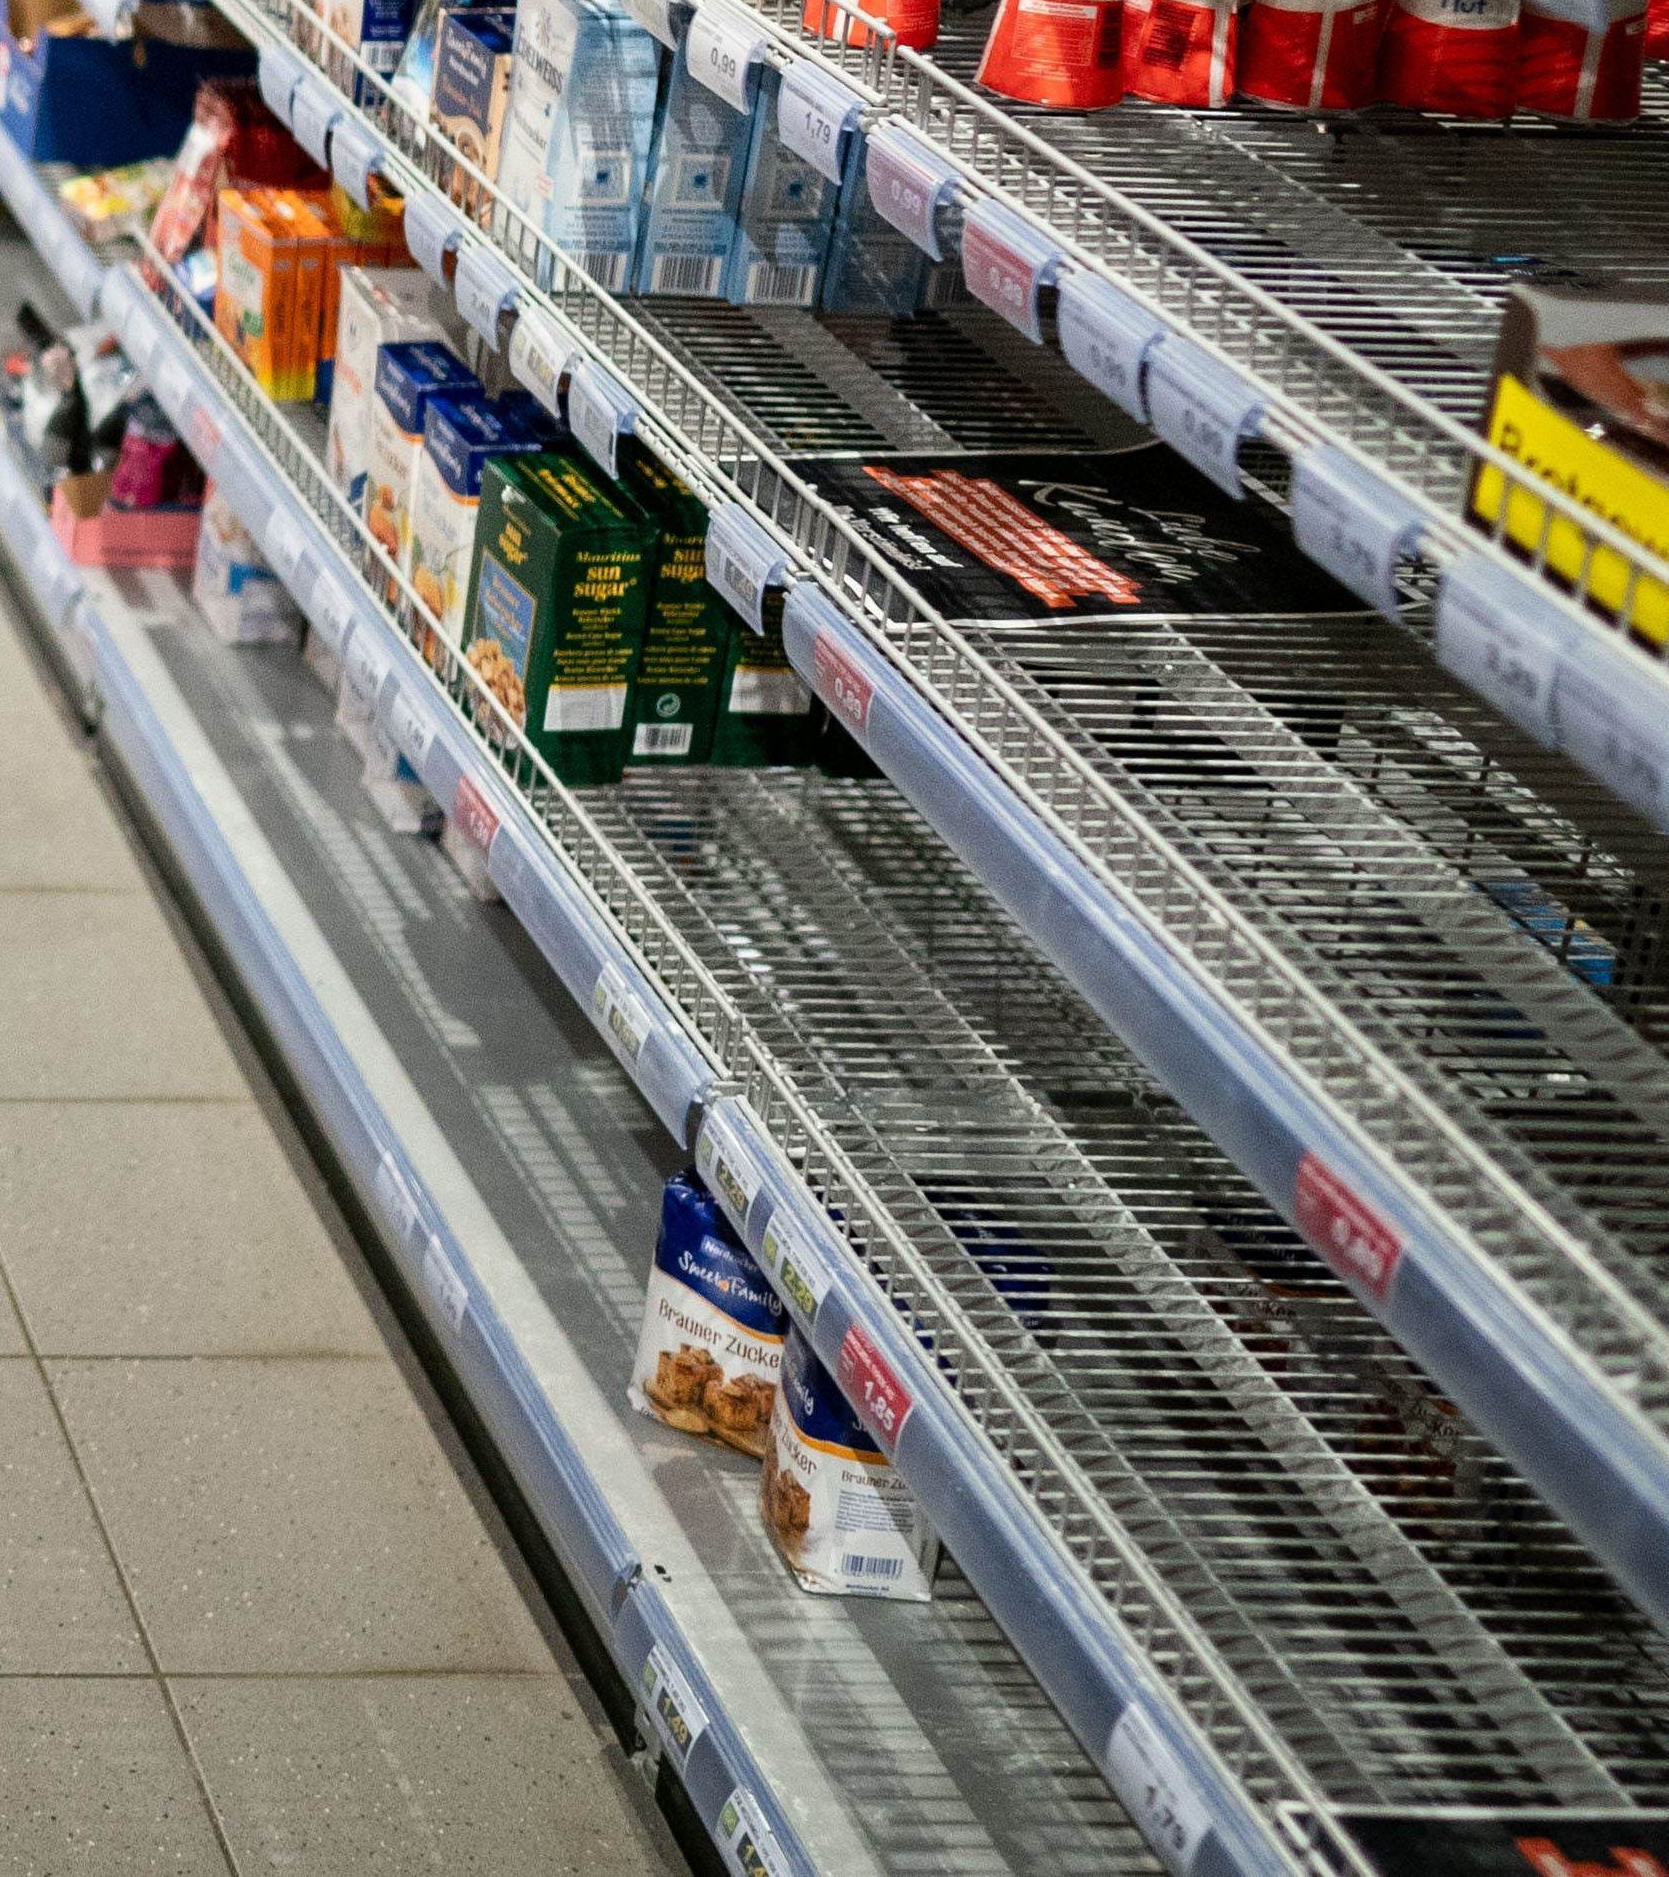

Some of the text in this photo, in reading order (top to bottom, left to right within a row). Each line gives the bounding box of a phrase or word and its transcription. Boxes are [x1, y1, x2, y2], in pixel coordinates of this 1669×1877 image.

[710, 48, 737, 79] 0,99
[804, 111, 832, 146] 1,79
[575, 551, 642, 563] Mauritius
[587, 565, 621, 581] sun
[678, 1249, 784, 1315] Sweet Family
[658, 1298, 781, 1369] Brauner Zucke
[863, 1379, 897, 1432] 1,85
[841, 1469, 889, 1490] Brauner
